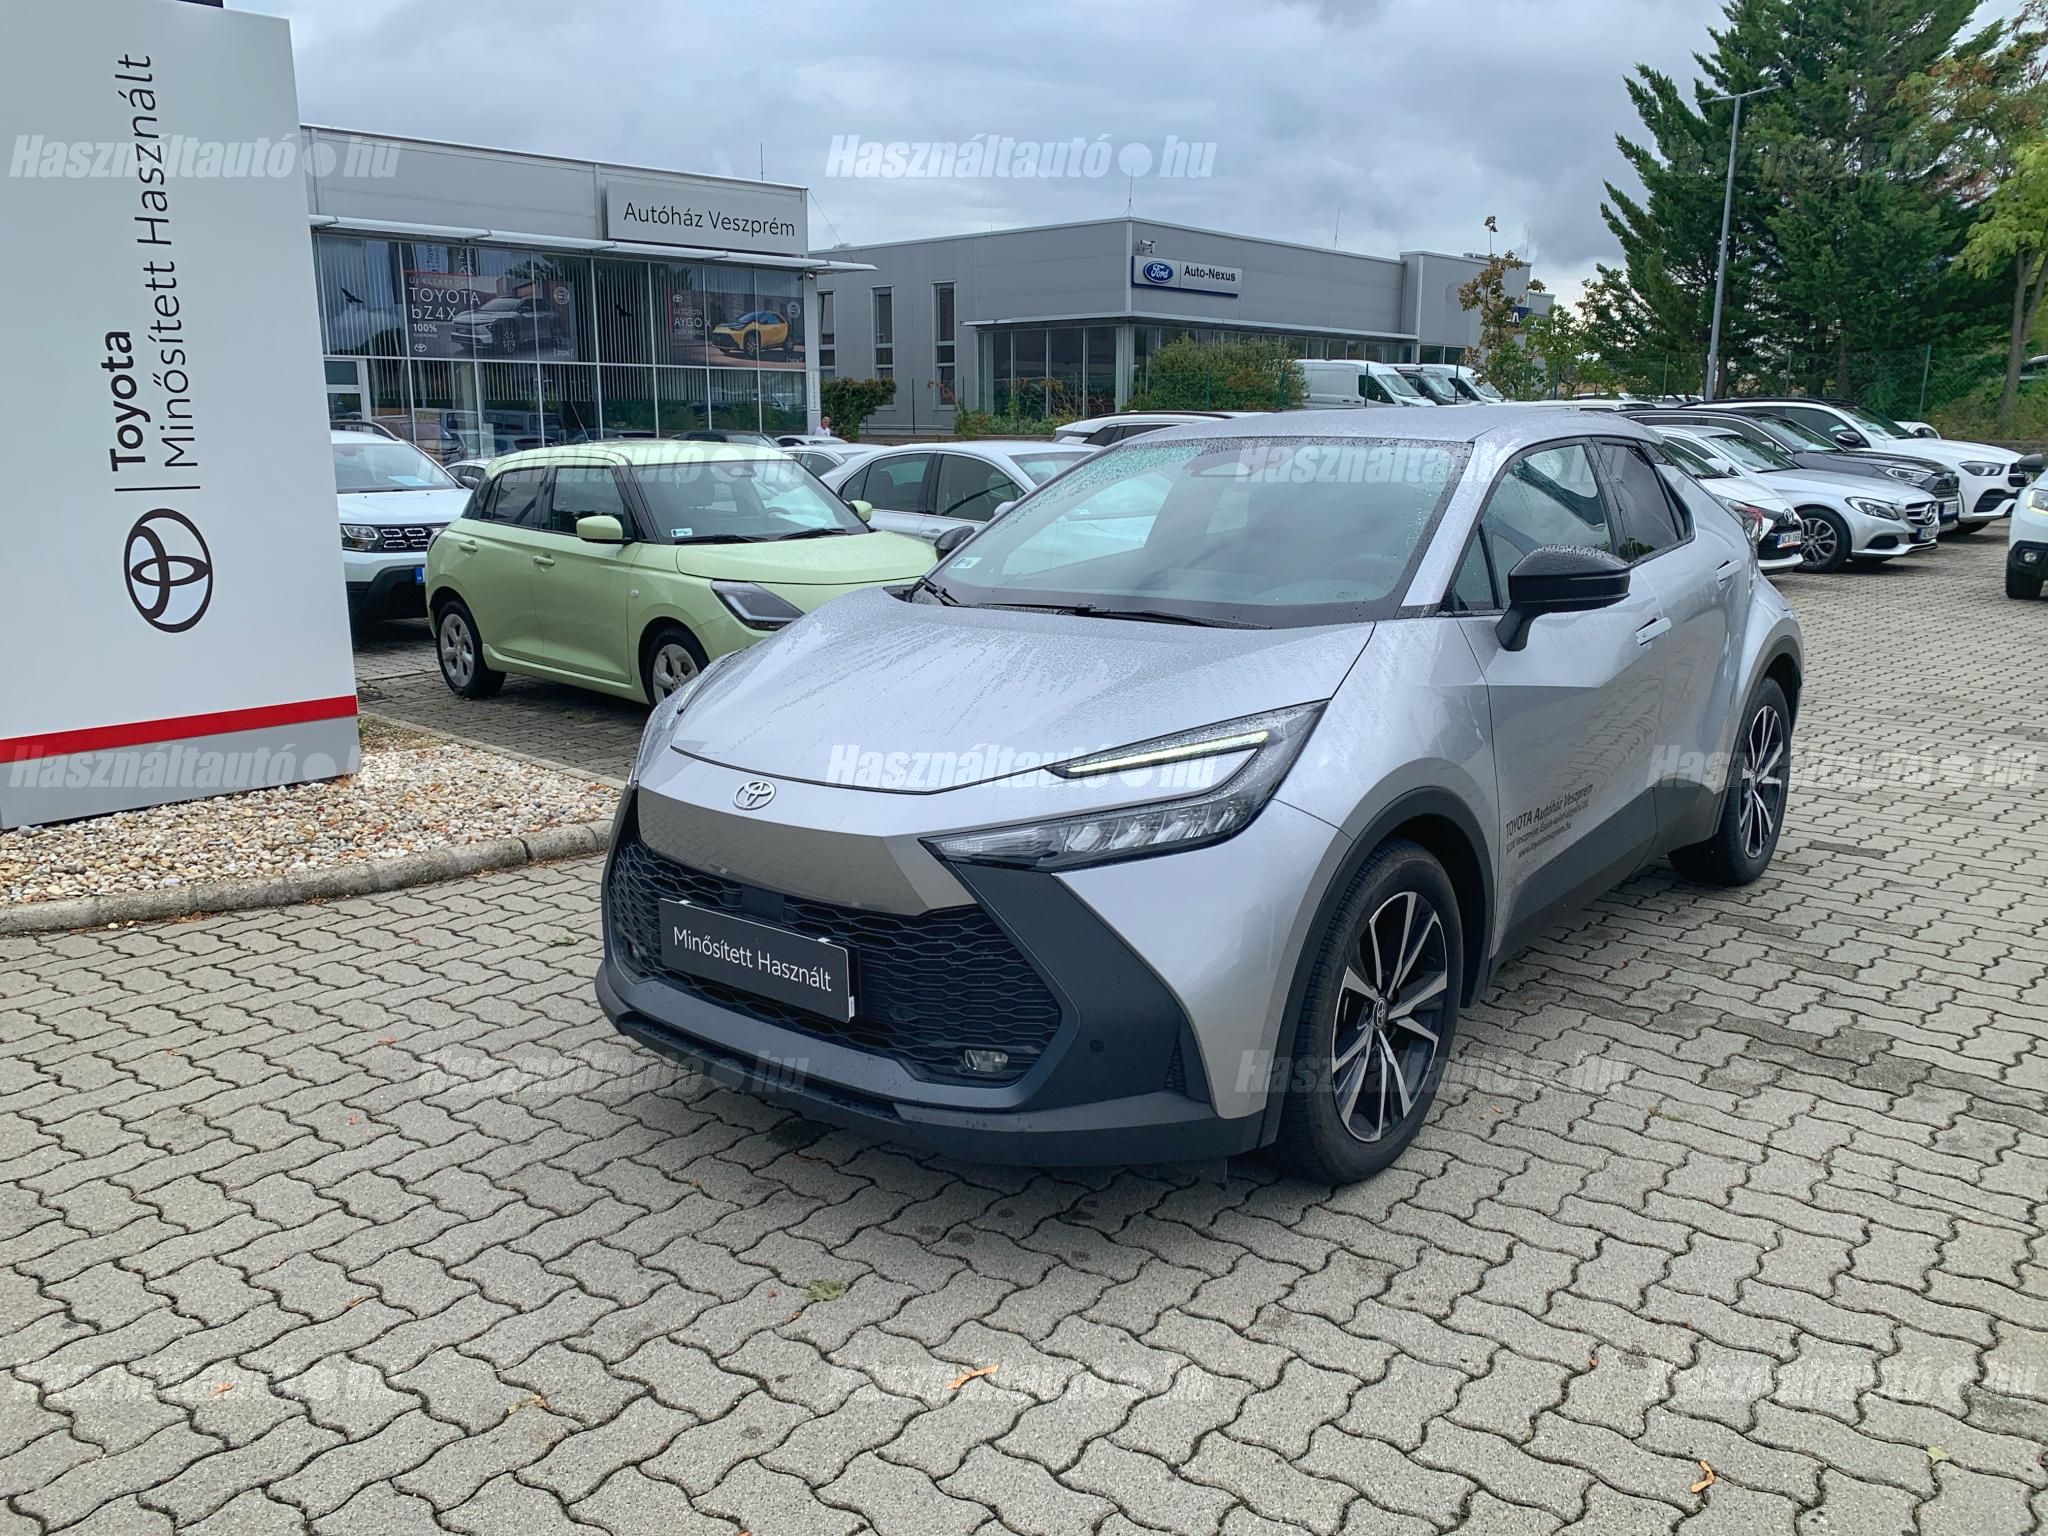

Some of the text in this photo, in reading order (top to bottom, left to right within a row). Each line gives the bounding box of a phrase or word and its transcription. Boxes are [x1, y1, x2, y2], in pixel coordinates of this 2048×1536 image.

[623, 201, 795, 238] Autóház Veszprém
[115, 53, 199, 467] Minősített Használt
[1184, 265, 1237, 282] Auto-Nexus
[409, 287, 480, 305] TOYOTA
[411, 304, 456, 320] bZ4X
[674, 317, 703, 327] AYGO
[413, 323, 437, 333] 100%
[100, 331, 151, 472] Toyota
[1506, 810, 1532, 838] TOYOTA
[673, 926, 832, 992] Minősített Használt
